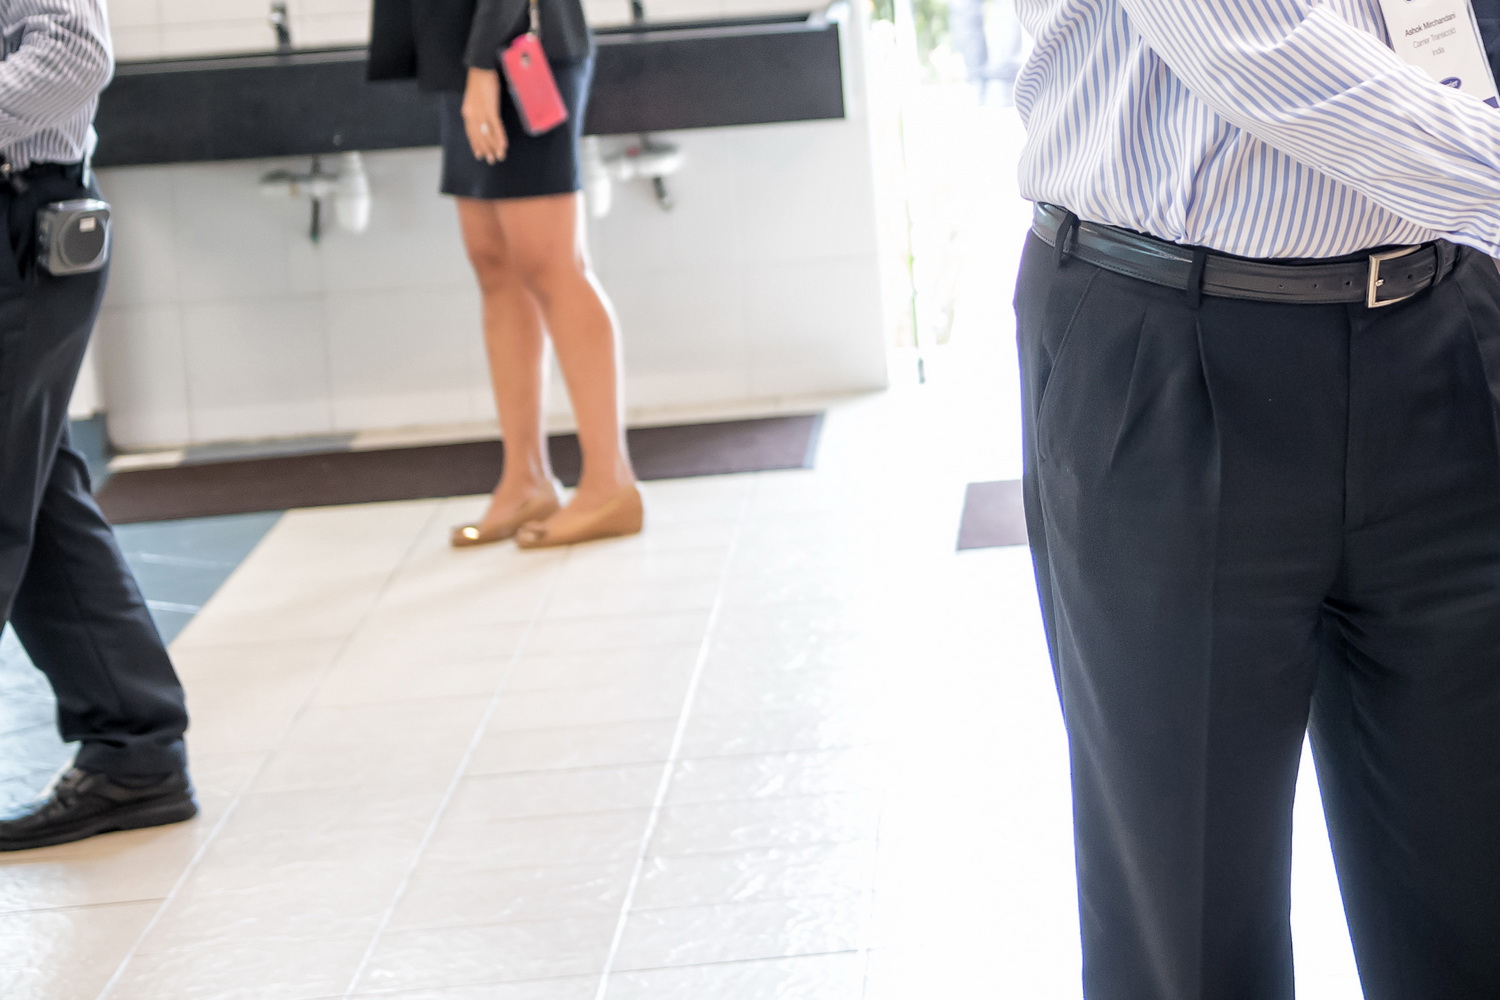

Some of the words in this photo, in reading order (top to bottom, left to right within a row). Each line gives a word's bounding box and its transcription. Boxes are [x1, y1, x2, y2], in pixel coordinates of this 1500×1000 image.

[1405, 24, 1423, 37] Ashok
[1423, 13, 1456, 29] Mirchandani
[1432, 46, 1445, 56] India
